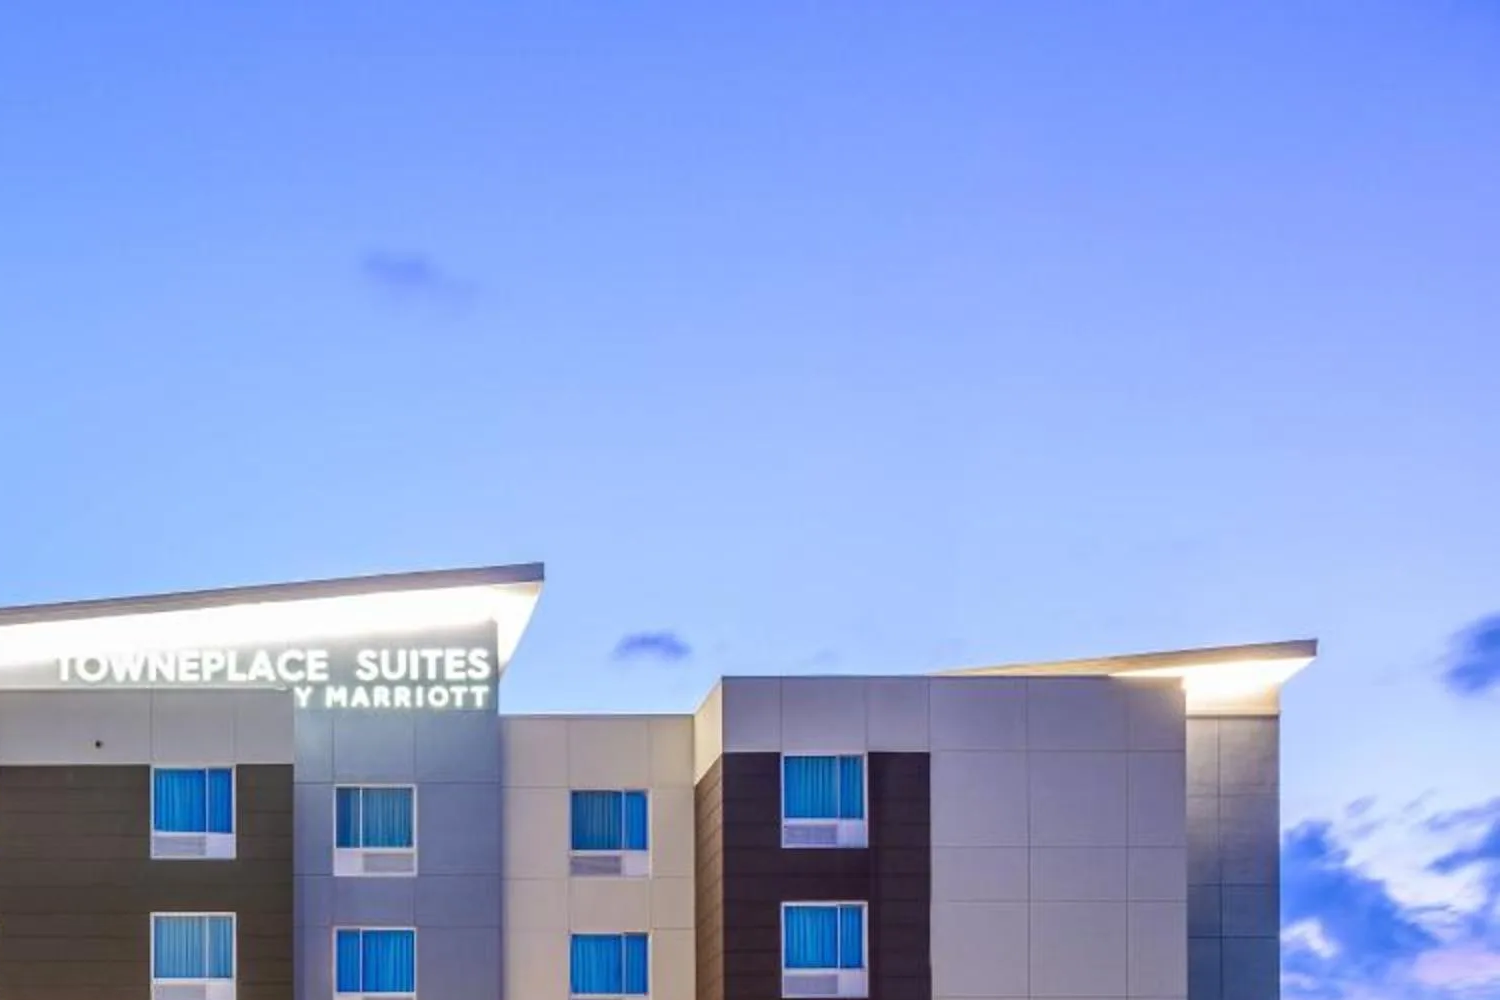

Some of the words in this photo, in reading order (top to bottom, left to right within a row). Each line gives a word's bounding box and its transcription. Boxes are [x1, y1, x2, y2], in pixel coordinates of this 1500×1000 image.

[57, 649, 329, 682] TOWNEPLACE
[355, 648, 491, 681] SUITES
[294, 686, 312, 708] Y
[325, 686, 489, 708] MARRIOTT
